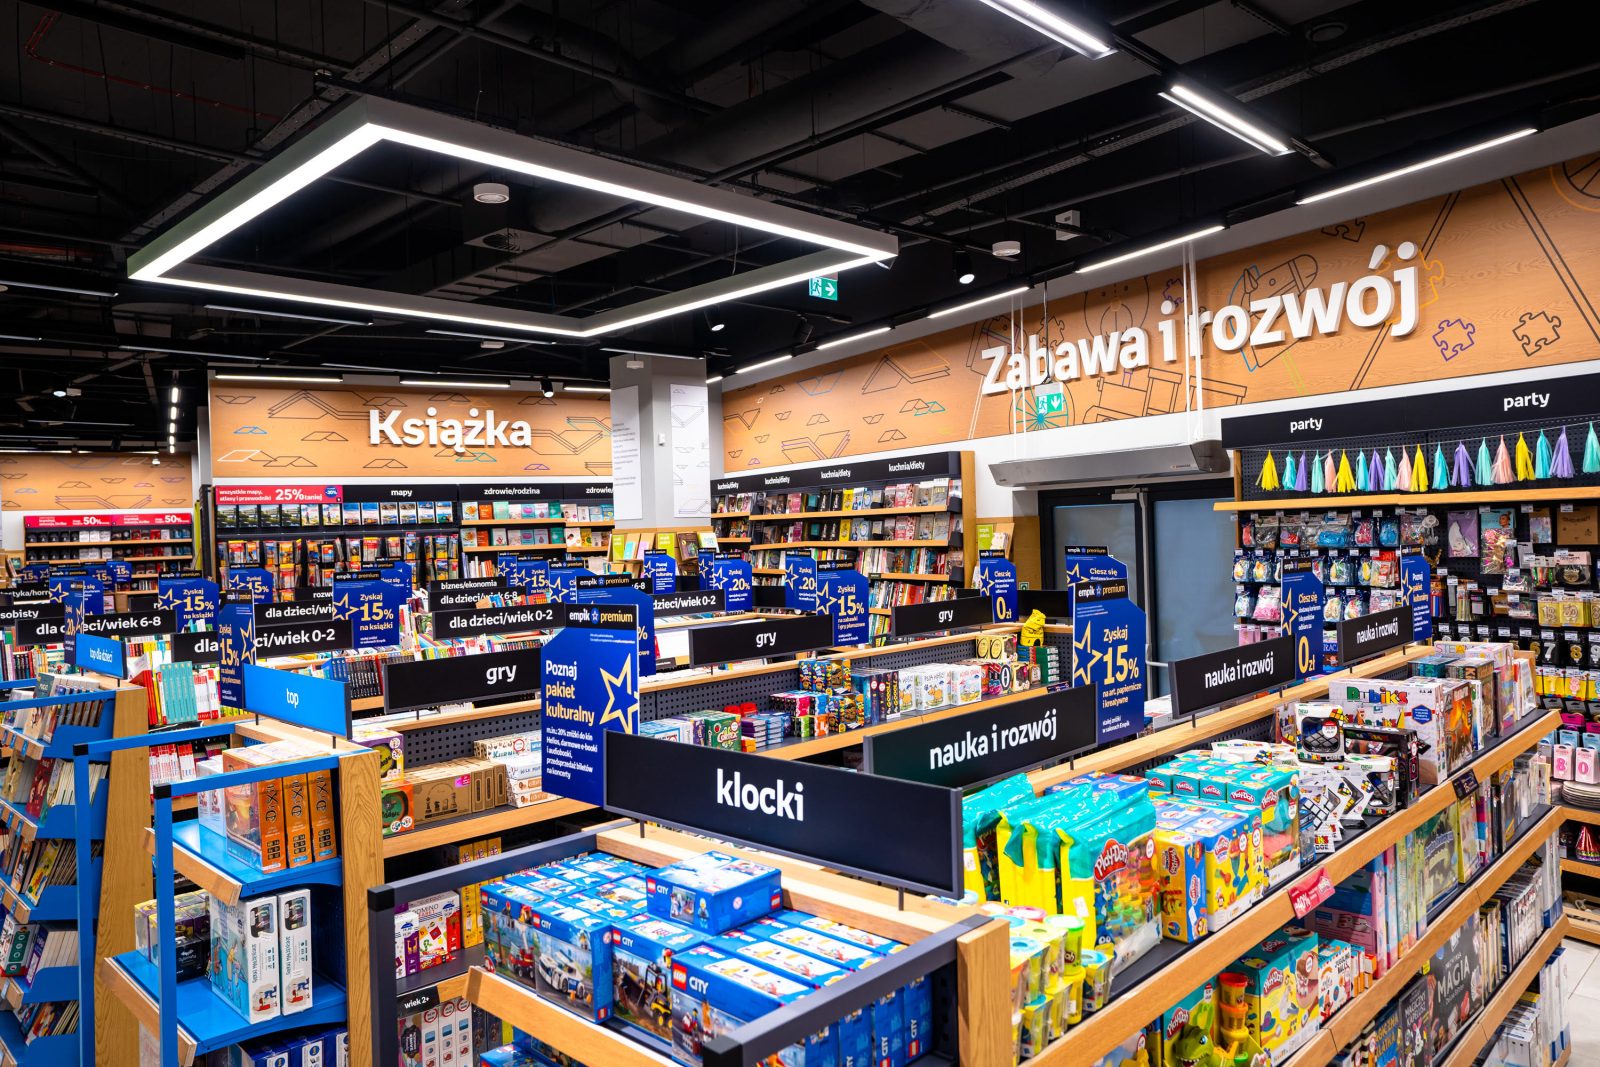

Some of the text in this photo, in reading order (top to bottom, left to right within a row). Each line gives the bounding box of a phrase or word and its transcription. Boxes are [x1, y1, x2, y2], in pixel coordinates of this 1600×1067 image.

[981, 241, 1419, 396] Zabawa i rozwój
[1503, 392, 1551, 411] party
[369, 406, 532, 454] Książka
[1290, 417, 1324, 433] party
[821, 469, 852, 480] kuchnia/diety
[888, 461, 926, 472] kuchnia/diety
[275, 488, 304, 501] 25%
[390, 488, 413, 499] mapy
[484, 487, 540, 496] zdrowie/rodzina
[83, 516, 102, 526] 50%
[164, 514, 182, 524] 50%
[1107, 568, 1118, 576] się
[248, 582, 269, 593] 15%
[441, 580, 497, 590] biznes/ekonomia
[838, 585, 856, 594] Zyskaj
[1078, 584, 1125, 597] empik premium
[184, 596, 214, 612] 15%
[360, 593, 383, 601] Zyskaj
[441, 596, 453, 604] dla
[702, 595, 716, 605] 0-2
[266, 608, 282, 619] dla
[360, 602, 394, 622] 15%
[838, 595, 865, 616] 15%
[996, 596, 1006, 620] 0
[450, 610, 553, 629] dla dzieci/wiek 0-2
[570, 608, 633, 623] empik premium
[939, 608, 954, 622] gry
[36, 623, 58, 635] dla
[140, 616, 162, 628] 6-8
[369, 622, 393, 631] książki
[1103, 625, 1128, 642] Zyskaj
[1356, 624, 1375, 644] nauka
[1378, 616, 1398, 637] rozwój
[194, 628, 336, 653] dla ci/wiek 0-2
[756, 632, 777, 648] gry
[220, 638, 240, 666] 15%
[1298, 635, 1316, 673] 0 zł
[1570, 645, 1582, 659] 8
[545, 660, 577, 681] Poznaj
[1103, 644, 1140, 686] 15%
[1204, 651, 1274, 688] nauka i rozwój
[486, 664, 517, 685] gry
[286, 688, 299, 705] top
[545, 680, 575, 699] pakiet
[545, 700, 595, 727] kulturalny
[930, 709, 1057, 770] nauka i rozwój
[716, 768, 804, 822] klocki
[657, 884, 668, 895] CITY
[622, 937, 634, 948] CITY
[689, 976, 708, 994] CITY
[1437, 955, 1470, 1004] MAGIA
[404, 998, 421, 1009] wiek
